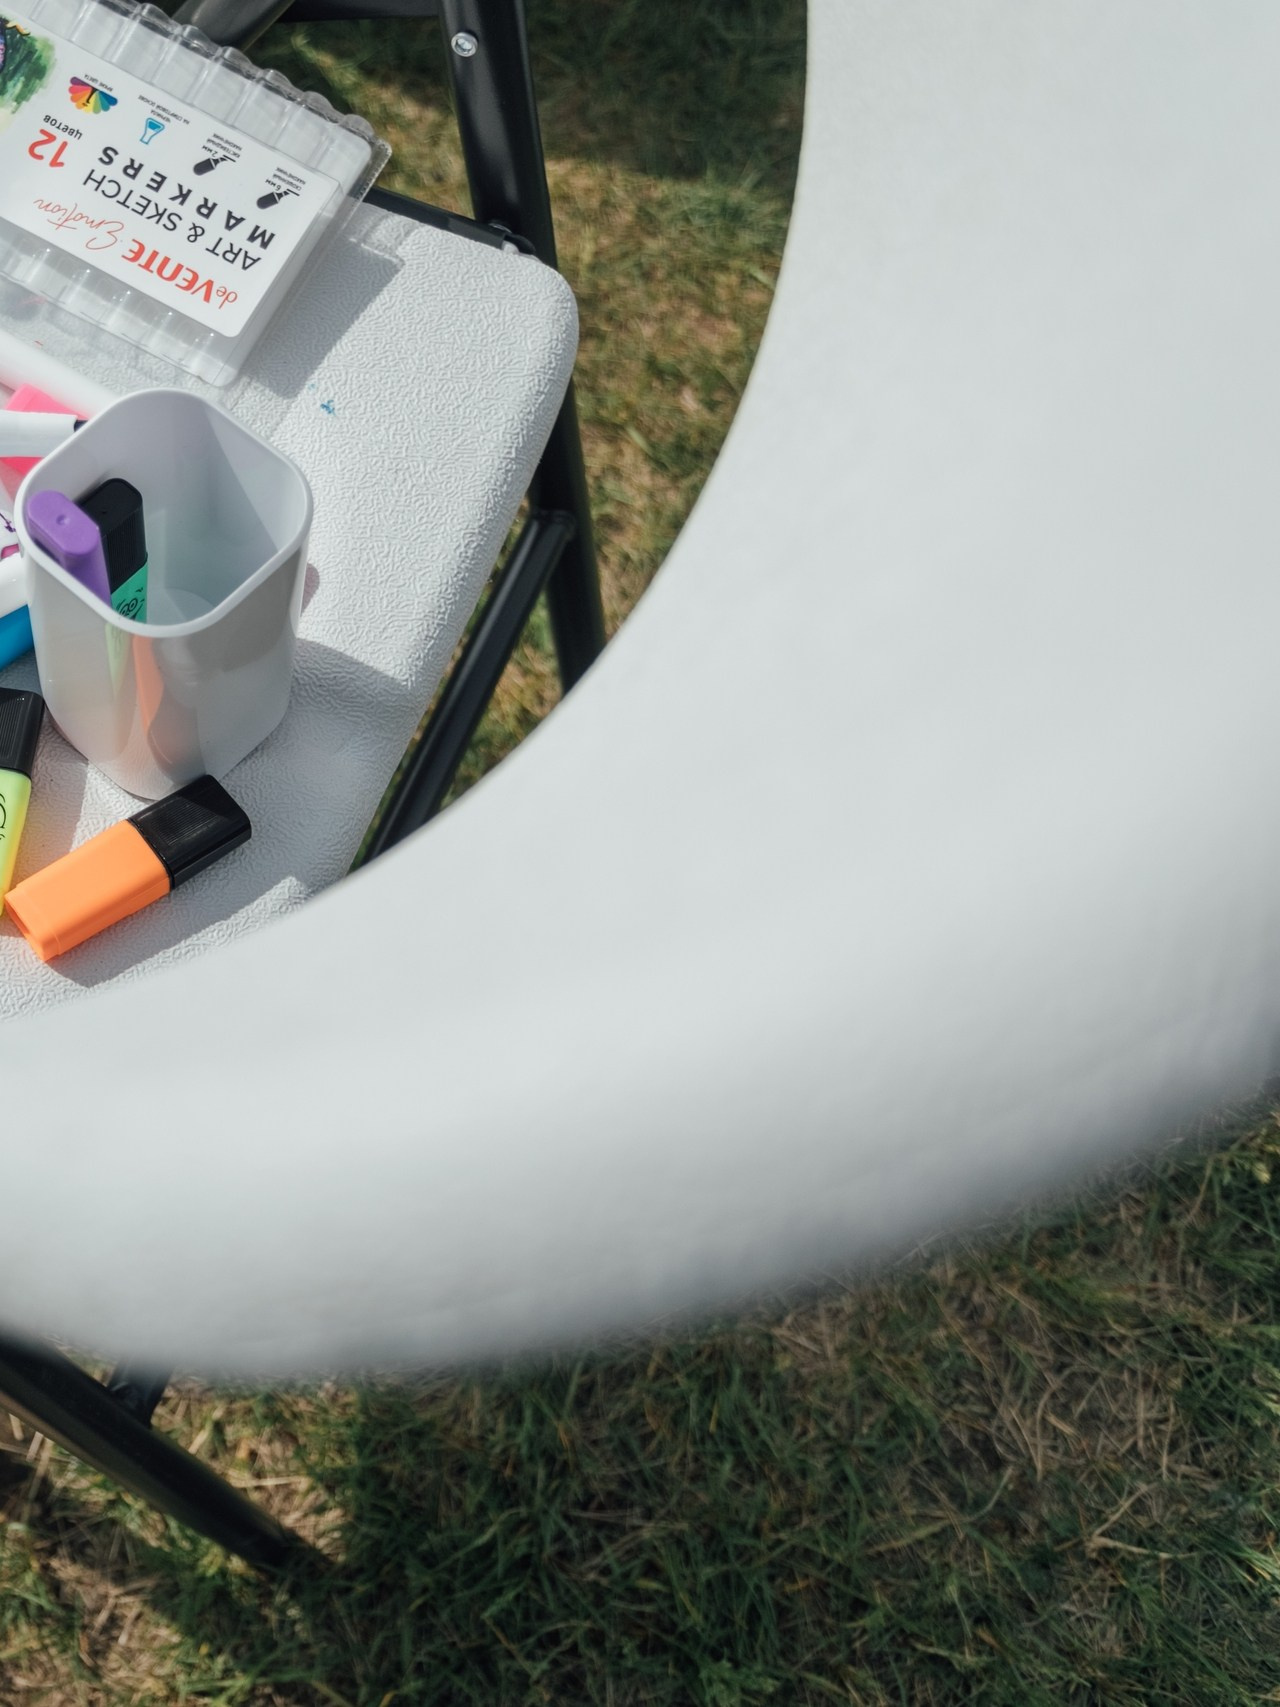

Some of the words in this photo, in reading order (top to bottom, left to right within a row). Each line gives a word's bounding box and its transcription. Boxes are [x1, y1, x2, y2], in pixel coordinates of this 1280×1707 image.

[28, 128, 69, 168] 12
[43, 114, 83, 140] цветов
[83, 169, 183, 232] SKETCH
[98, 146, 275, 250] MARKERS
[33, 198, 124, 250] Emotion
[187, 222, 205, 243] &
[122, 238, 238, 310] deVENTE
[206, 237, 261, 271] ART
